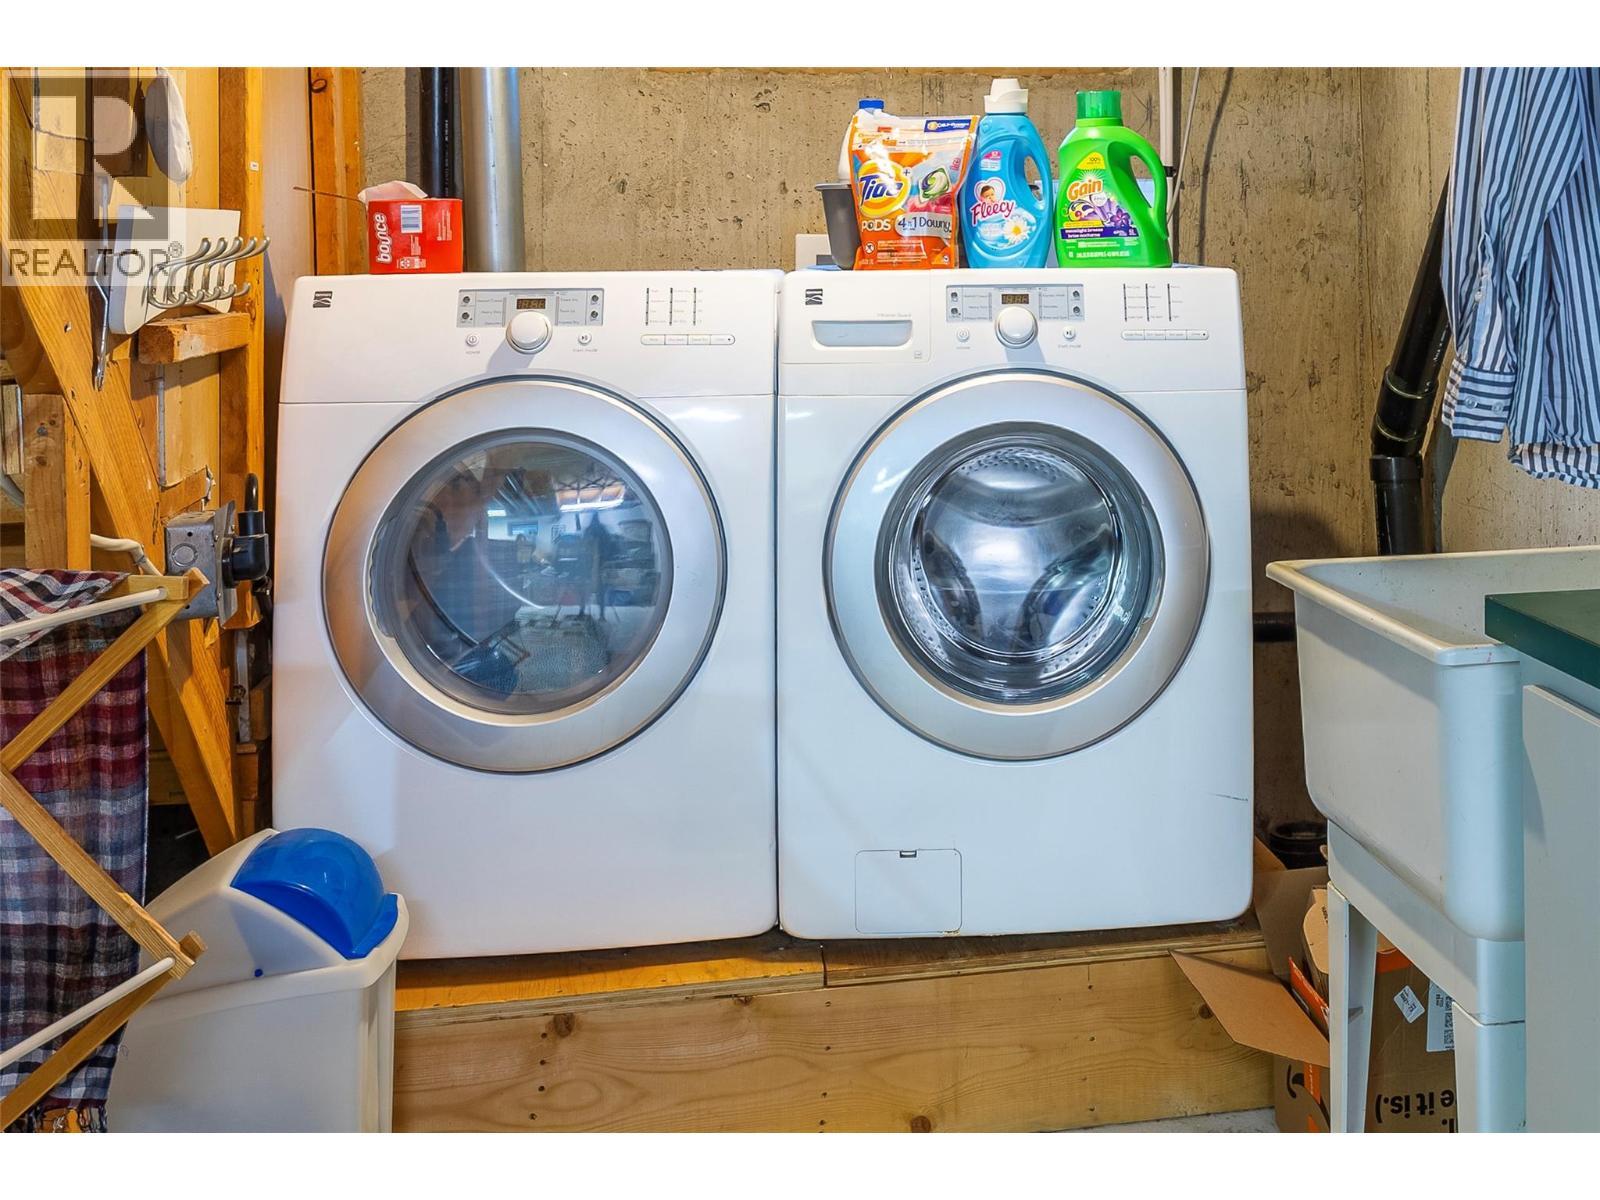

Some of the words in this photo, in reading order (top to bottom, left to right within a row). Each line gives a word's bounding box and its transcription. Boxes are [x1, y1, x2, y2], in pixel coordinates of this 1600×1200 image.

[1068, 179, 1102, 201] Gain
[898, 217, 906, 228] 4
[919, 217, 951, 233] Downy
[971, 201, 1015, 225] Fleecy
[374, 212, 391, 263] bounce
[862, 219, 891, 232] PODS
[1375, 1094, 1411, 1124] is.)
[1416, 1092, 1435, 1116] it
